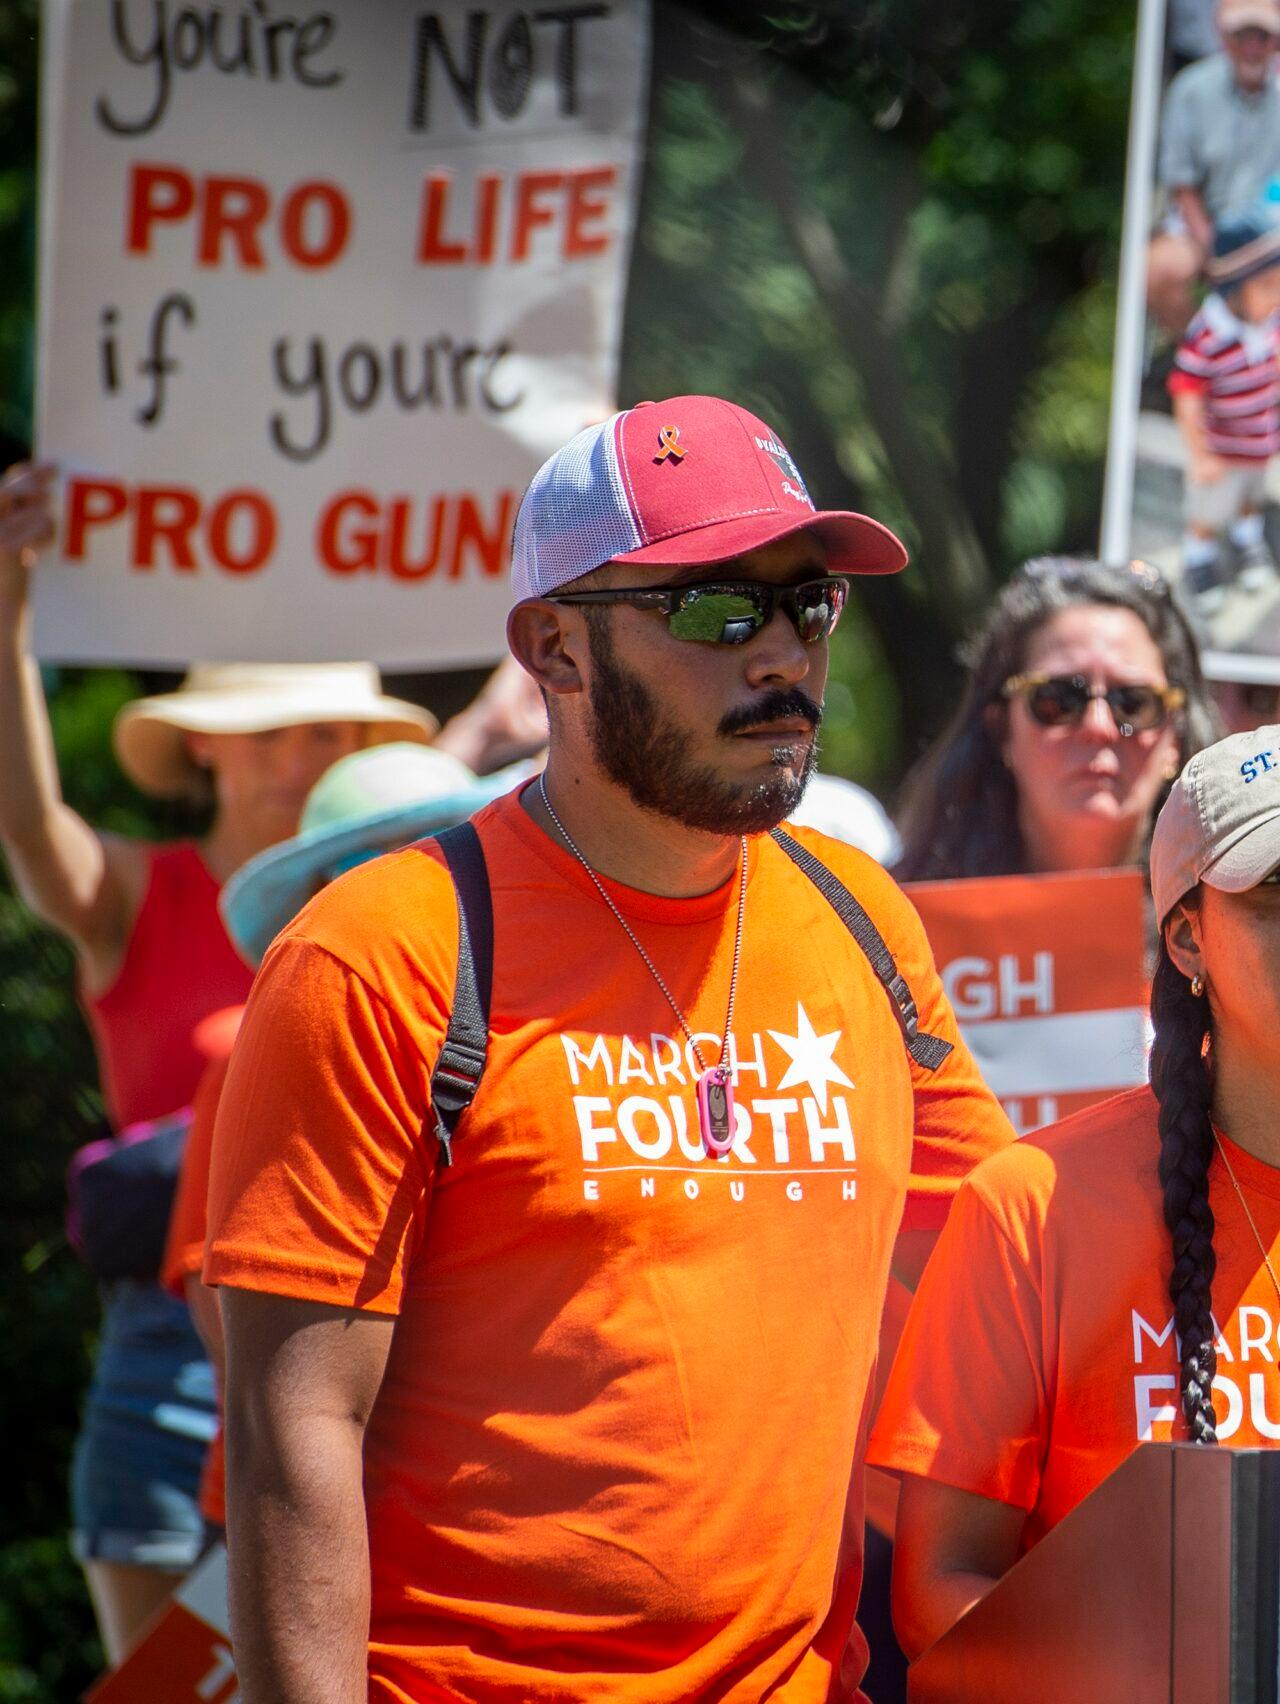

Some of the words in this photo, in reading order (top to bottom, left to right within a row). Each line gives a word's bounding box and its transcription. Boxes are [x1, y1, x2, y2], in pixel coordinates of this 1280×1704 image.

[95, 0, 345, 139] you're
[408, 3, 608, 133] NOT
[126, 162, 350, 271] PRO
[418, 165, 619, 264] LIFE
[103, 294, 194, 424] if
[63, 477, 278, 575] PRO
[317, 490, 512, 584] GUN
[1240, 751, 1278, 784] ST.
[560, 1032, 768, 1088] MARCH
[584, 1178, 857, 1202] ENOUGH
